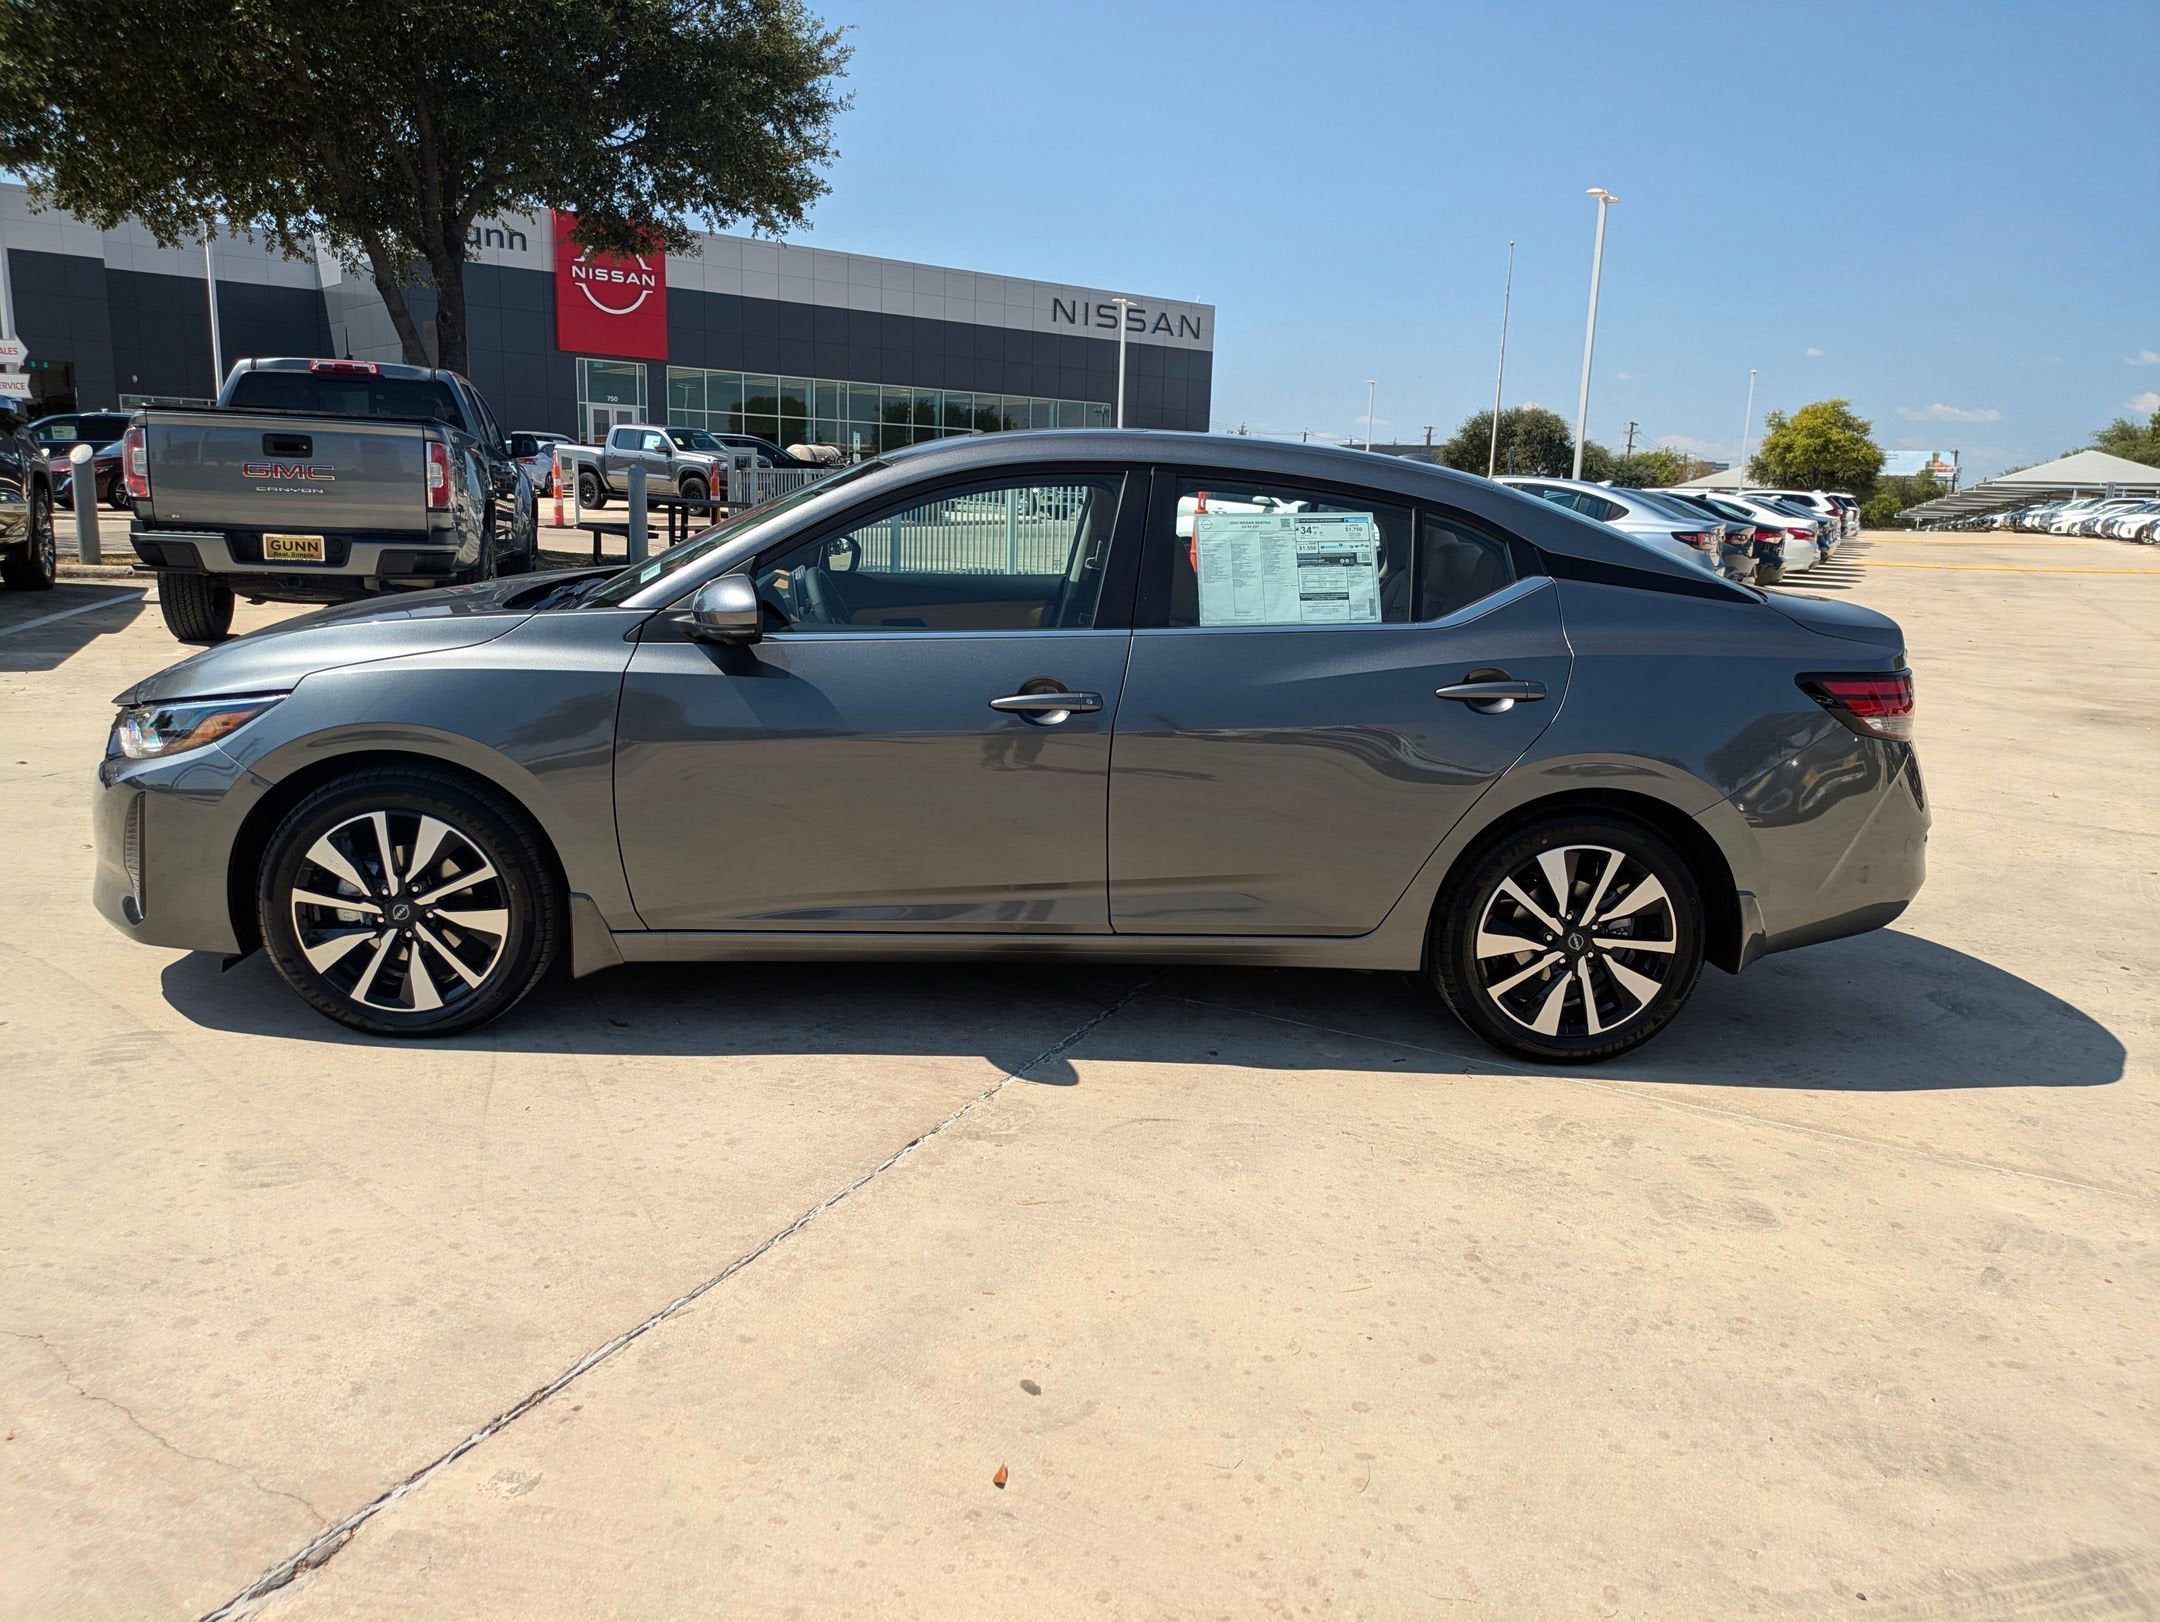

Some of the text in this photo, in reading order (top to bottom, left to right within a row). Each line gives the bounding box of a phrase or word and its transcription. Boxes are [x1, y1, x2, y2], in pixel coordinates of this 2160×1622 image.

[465, 226, 527, 251] unn
[571, 265, 655, 287] NISSAN
[1053, 297, 1201, 340] NISSAN
[0, 347, 18, 355] ALES
[0, 382, 25, 390] ERVICE
[242, 463, 335, 480] GMC
[1300, 526, 1312, 534] 34
[270, 540, 319, 552] GUNN
